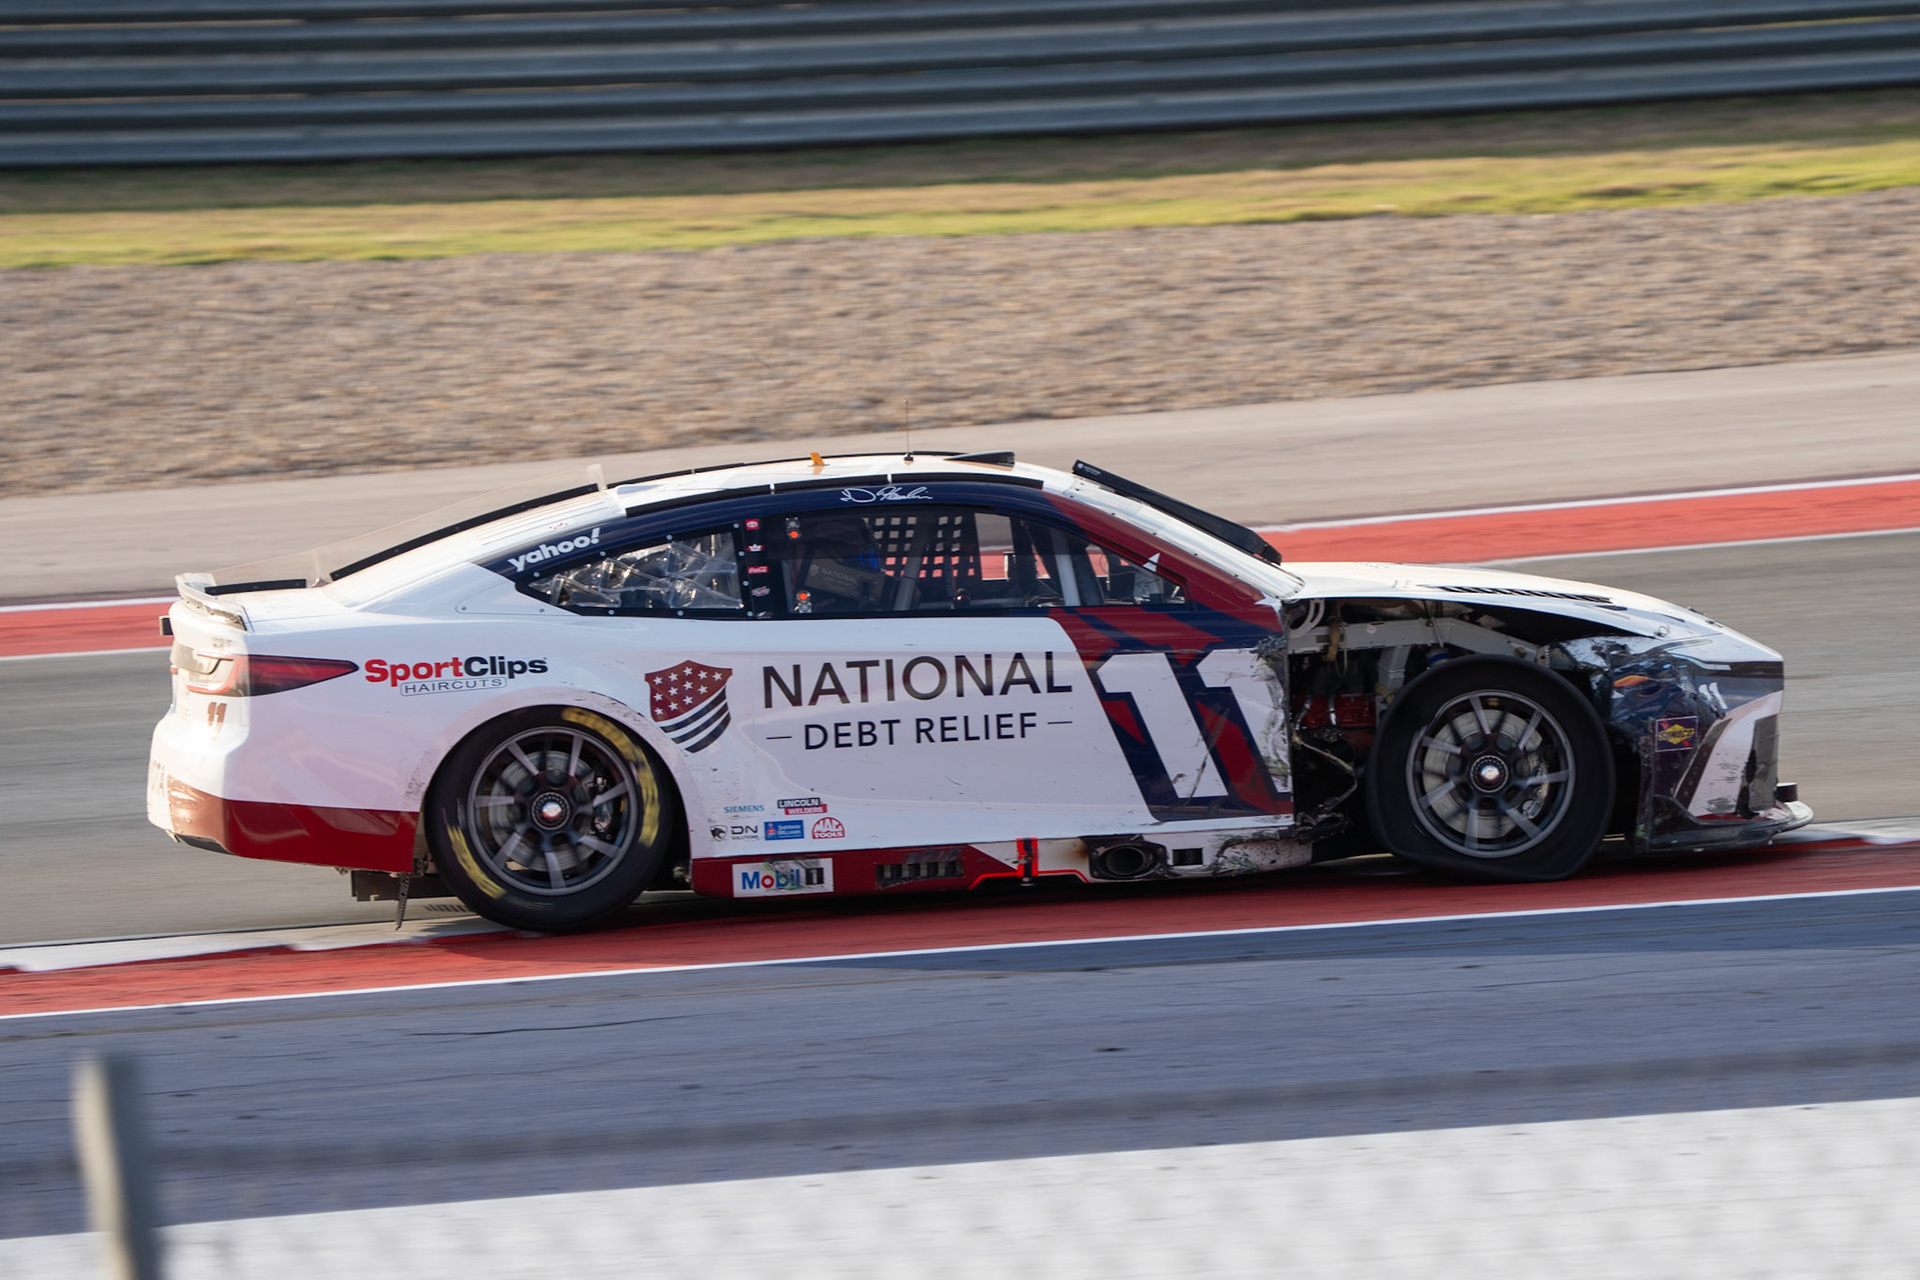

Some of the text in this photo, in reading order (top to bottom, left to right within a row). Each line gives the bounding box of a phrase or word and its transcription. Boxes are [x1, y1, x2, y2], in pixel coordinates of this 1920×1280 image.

[507, 527, 600, 572] yahoo!
[405, 679, 502, 693] HAIRCUTS
[763, 651, 1073, 708] NATIONAL
[804, 712, 1037, 750] DEBT RELIEF
[1097, 649, 1292, 799] 11
[724, 805, 765, 814] SIEMENS
[778, 798, 820, 808] LINCOLN
[731, 825, 758, 835] DN
[814, 831, 844, 839] TOOLS
[742, 868, 800, 889] Mobil
